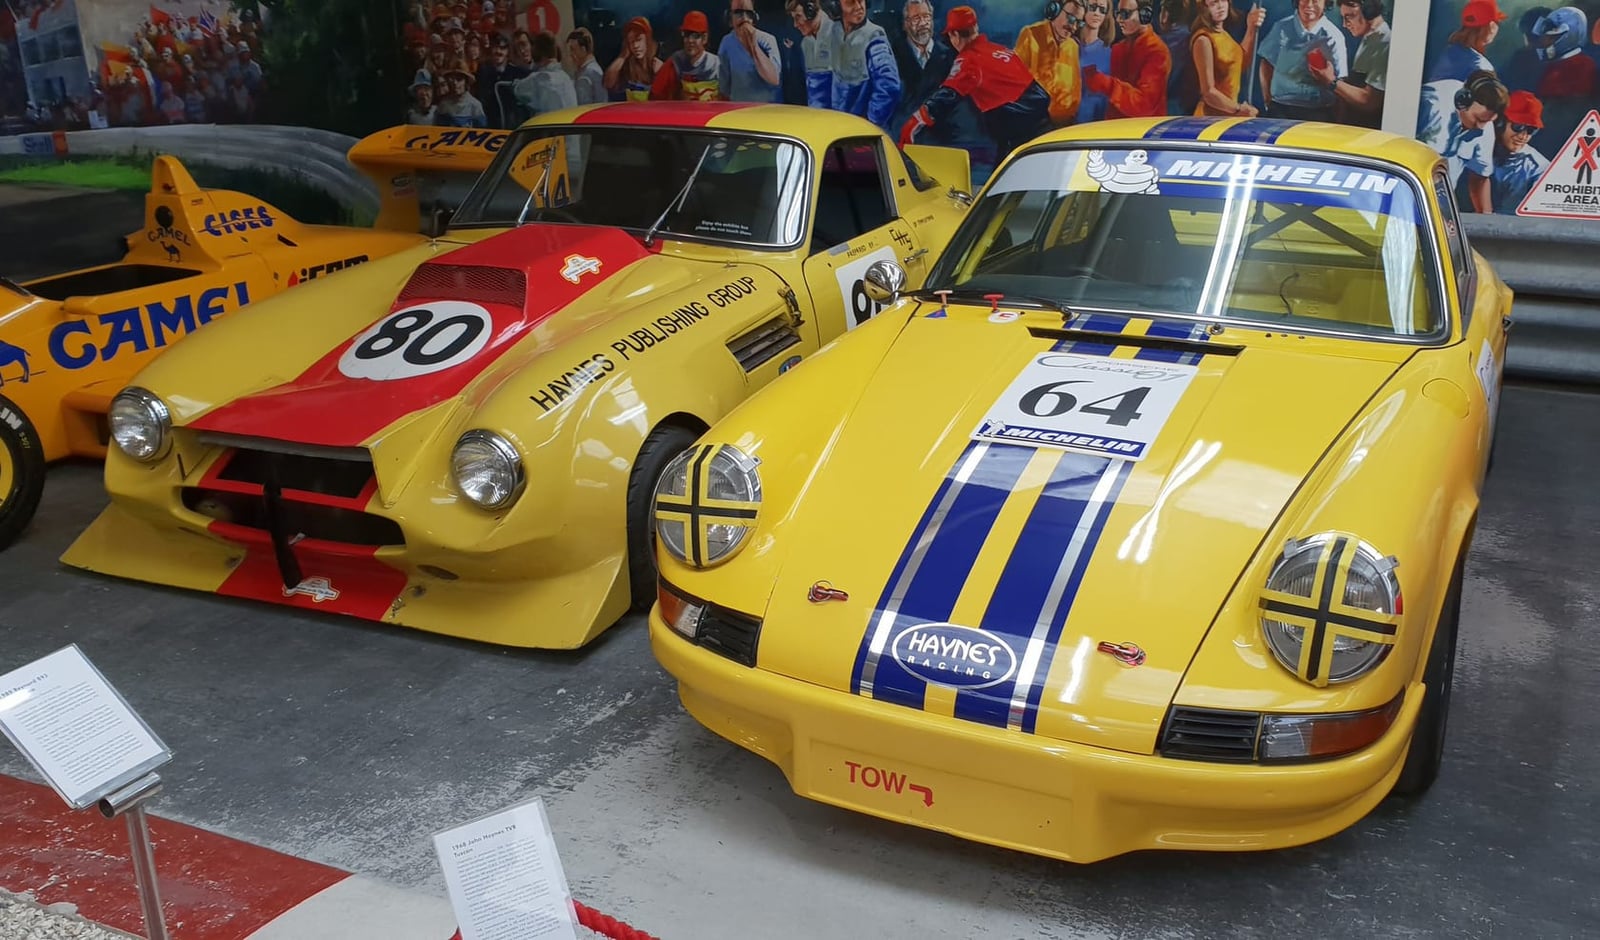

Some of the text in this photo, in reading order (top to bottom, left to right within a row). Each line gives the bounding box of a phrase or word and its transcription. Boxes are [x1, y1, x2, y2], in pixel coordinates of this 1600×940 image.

[405, 130, 511, 152] CAME
[1165, 159, 1399, 195] MICHELIN
[1563, 195, 1600, 205] AREA
[147, 227, 191, 247] CAMEL
[355, 309, 485, 366] 80
[529, 276, 759, 413] HAYNES PUBLISHING GROUP
[1018, 380, 1152, 427] 64
[1003, 427, 1140, 453] MICHELIN
[908, 631, 1001, 667] HAYNES
[907, 655, 991, 679] RACING
[844, 761, 907, 794] TOW
